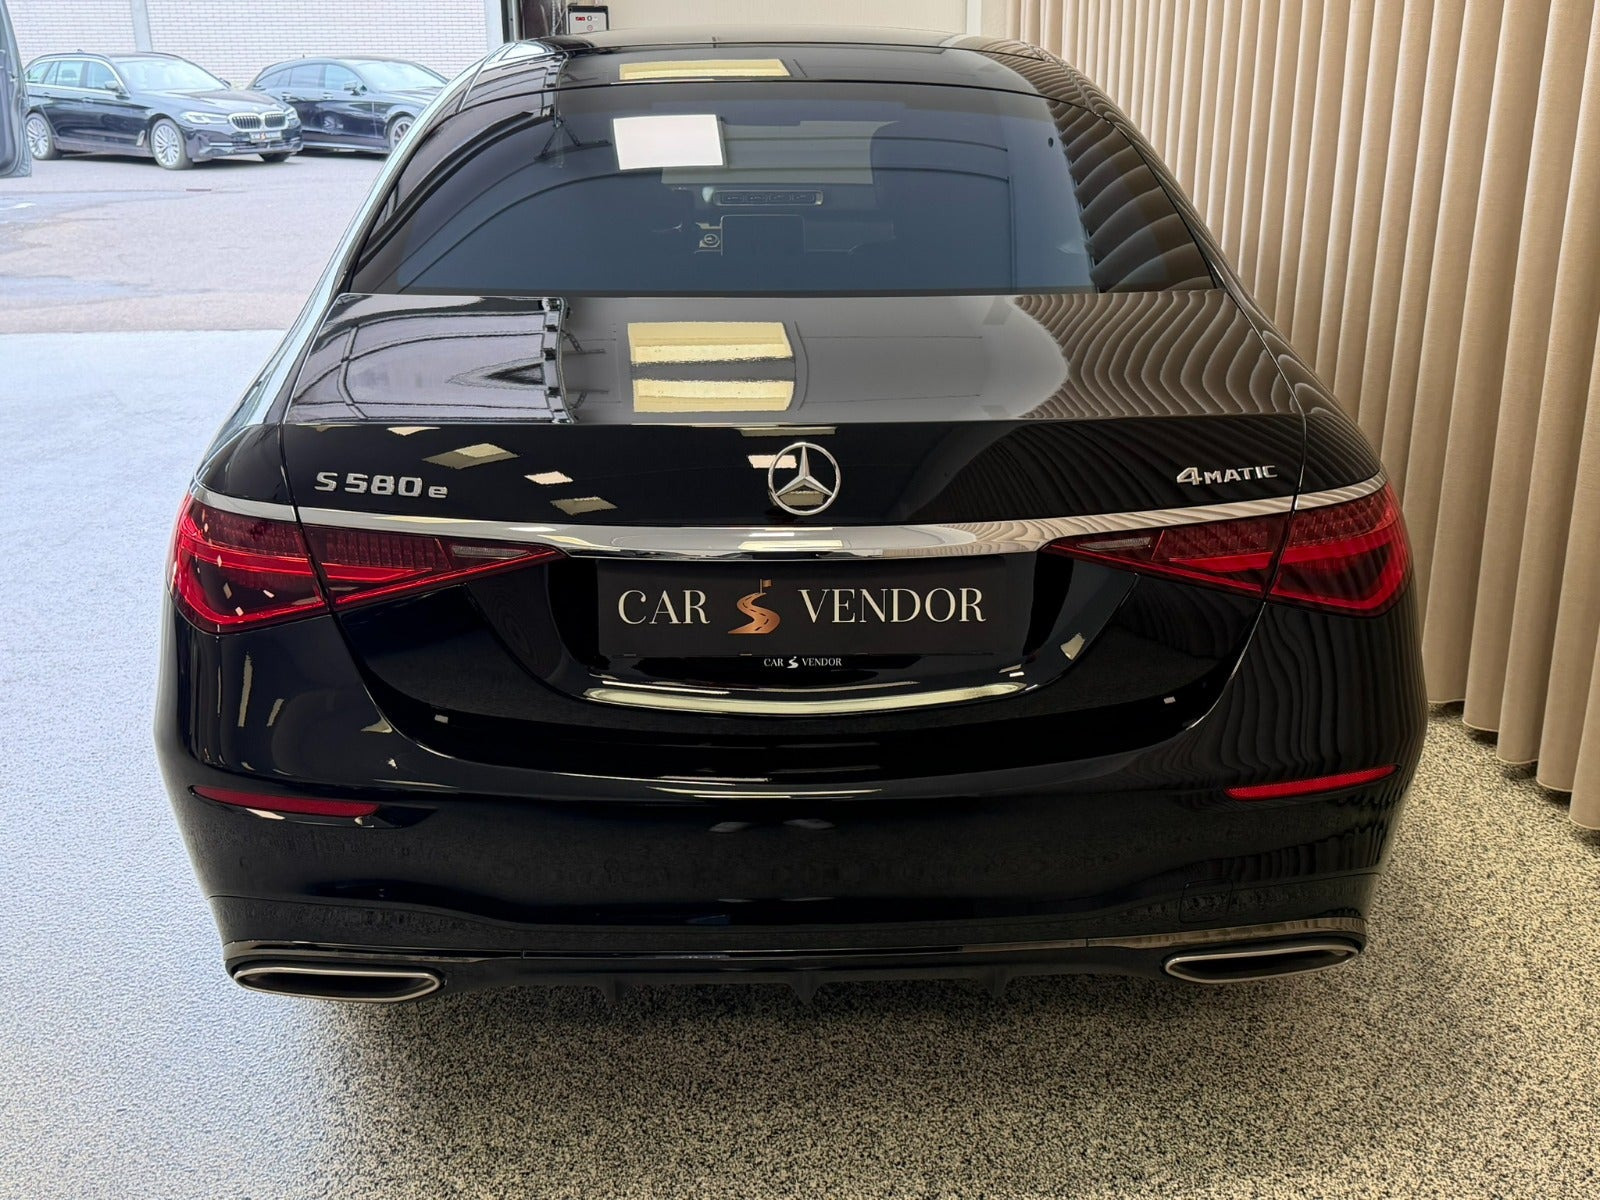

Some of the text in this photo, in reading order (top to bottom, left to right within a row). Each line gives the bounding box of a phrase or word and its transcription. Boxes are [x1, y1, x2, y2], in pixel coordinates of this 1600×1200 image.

[314, 471, 338, 492] S
[1176, 465, 1278, 486] 4MATIC
[617, 587, 987, 625] CAR VENDOR
[763, 657, 843, 667] CAR VENDOR
